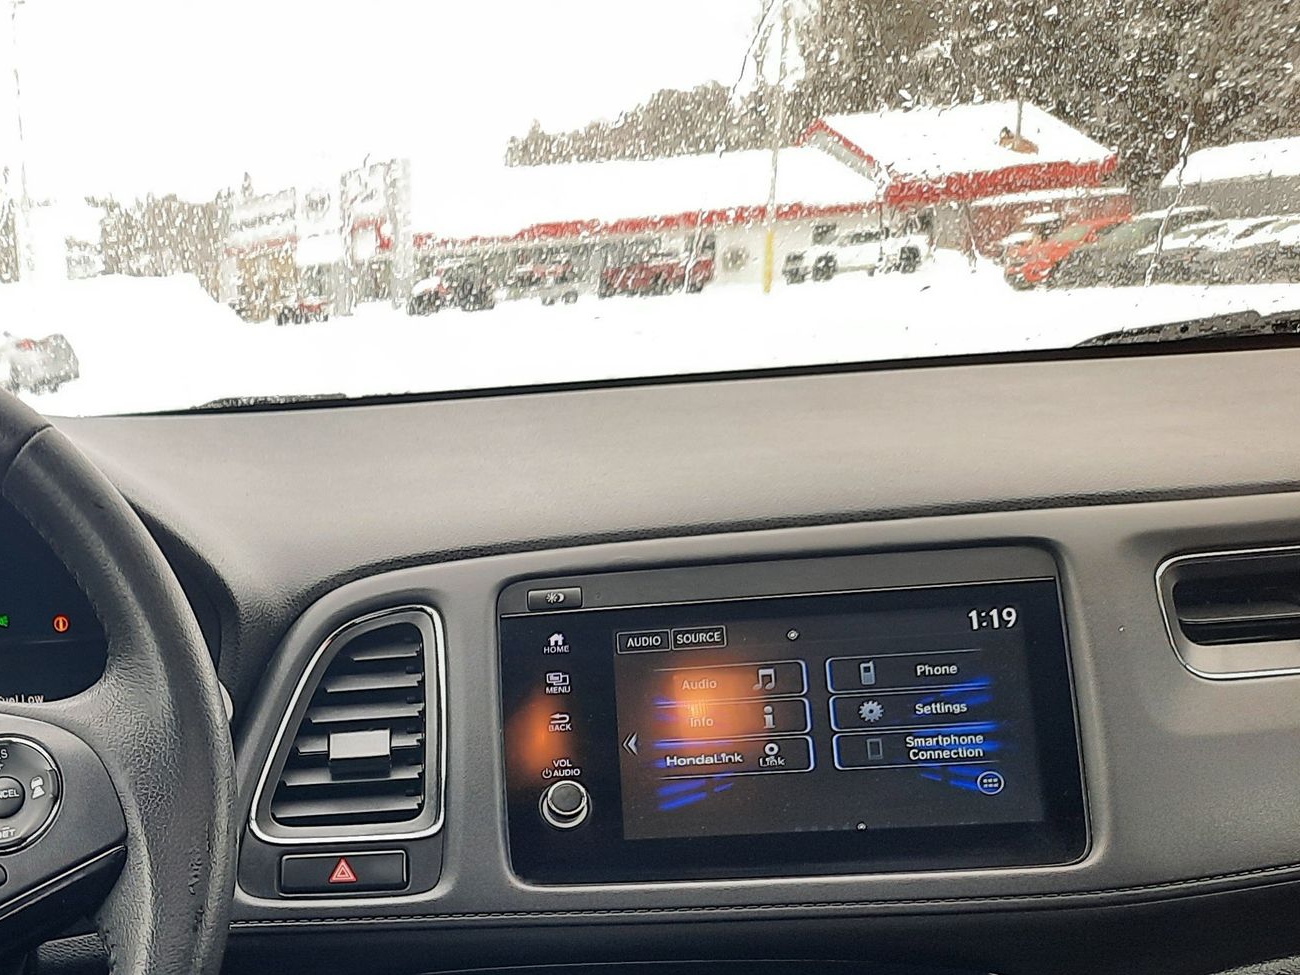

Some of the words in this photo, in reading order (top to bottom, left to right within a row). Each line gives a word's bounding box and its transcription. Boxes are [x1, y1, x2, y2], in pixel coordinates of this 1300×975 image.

[968, 607, 1016, 630] 1:19
[626, 635, 662, 648] AUDIO
[676, 631, 722, 645] SOURCE
[543, 645, 570, 654] HOME
[916, 664, 958, 677] Phone
[545, 685, 571, 694] MENU
[682, 678, 717, 690] Audio
[915, 702, 967, 716] Settings
[548, 722, 572, 732] BACK
[688, 716, 714, 728] Info
[905, 734, 984, 748] Smartphone
[666, 752, 743, 767] HondaLink
[909, 747, 984, 761] Connection
[553, 759, 573, 768] VOL
[553, 767, 581, 777] AUDIO
